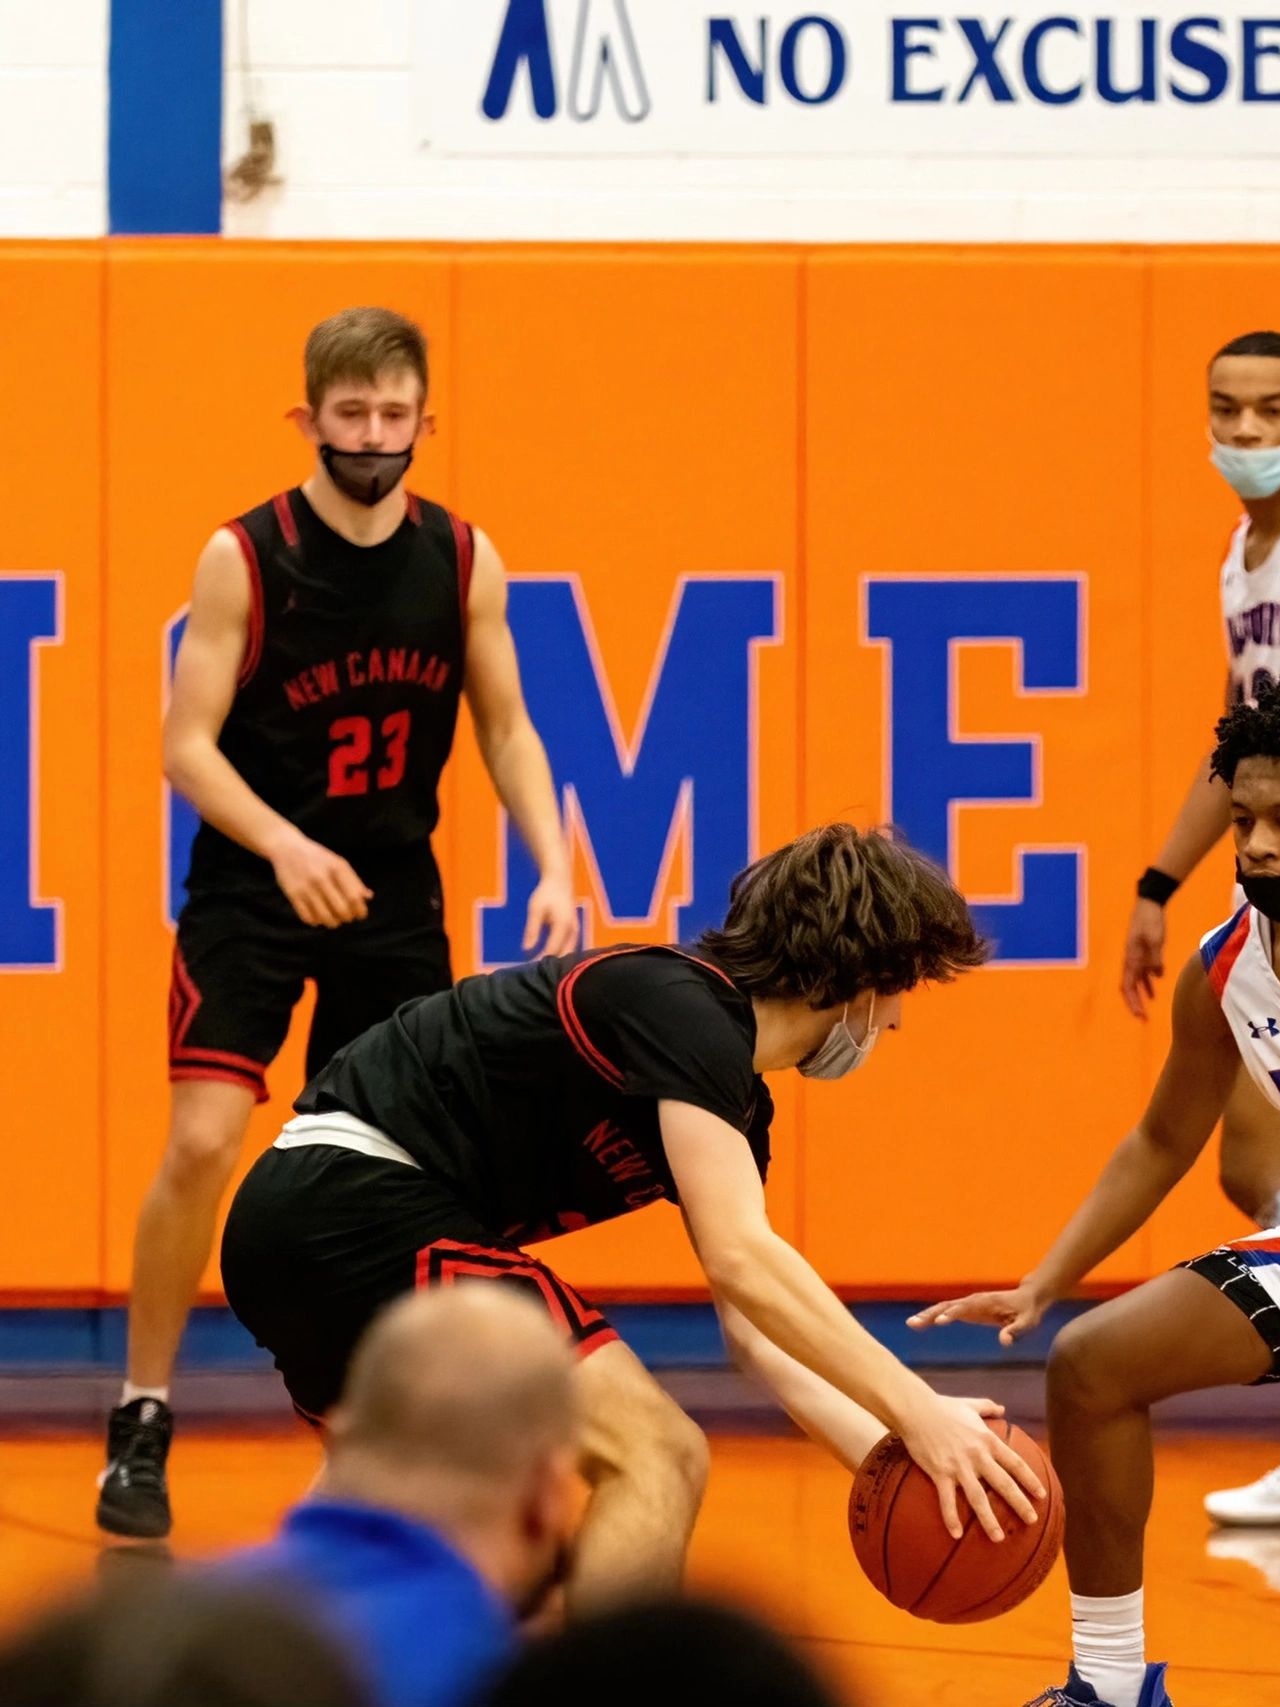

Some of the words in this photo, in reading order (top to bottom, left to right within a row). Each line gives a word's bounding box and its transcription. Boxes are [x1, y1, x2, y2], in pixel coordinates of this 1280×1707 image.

[706, 16, 848, 105] NO
[283, 659, 341, 712] NEW
[326, 709, 411, 797] 23
[582, 1118, 653, 1184] NEW
